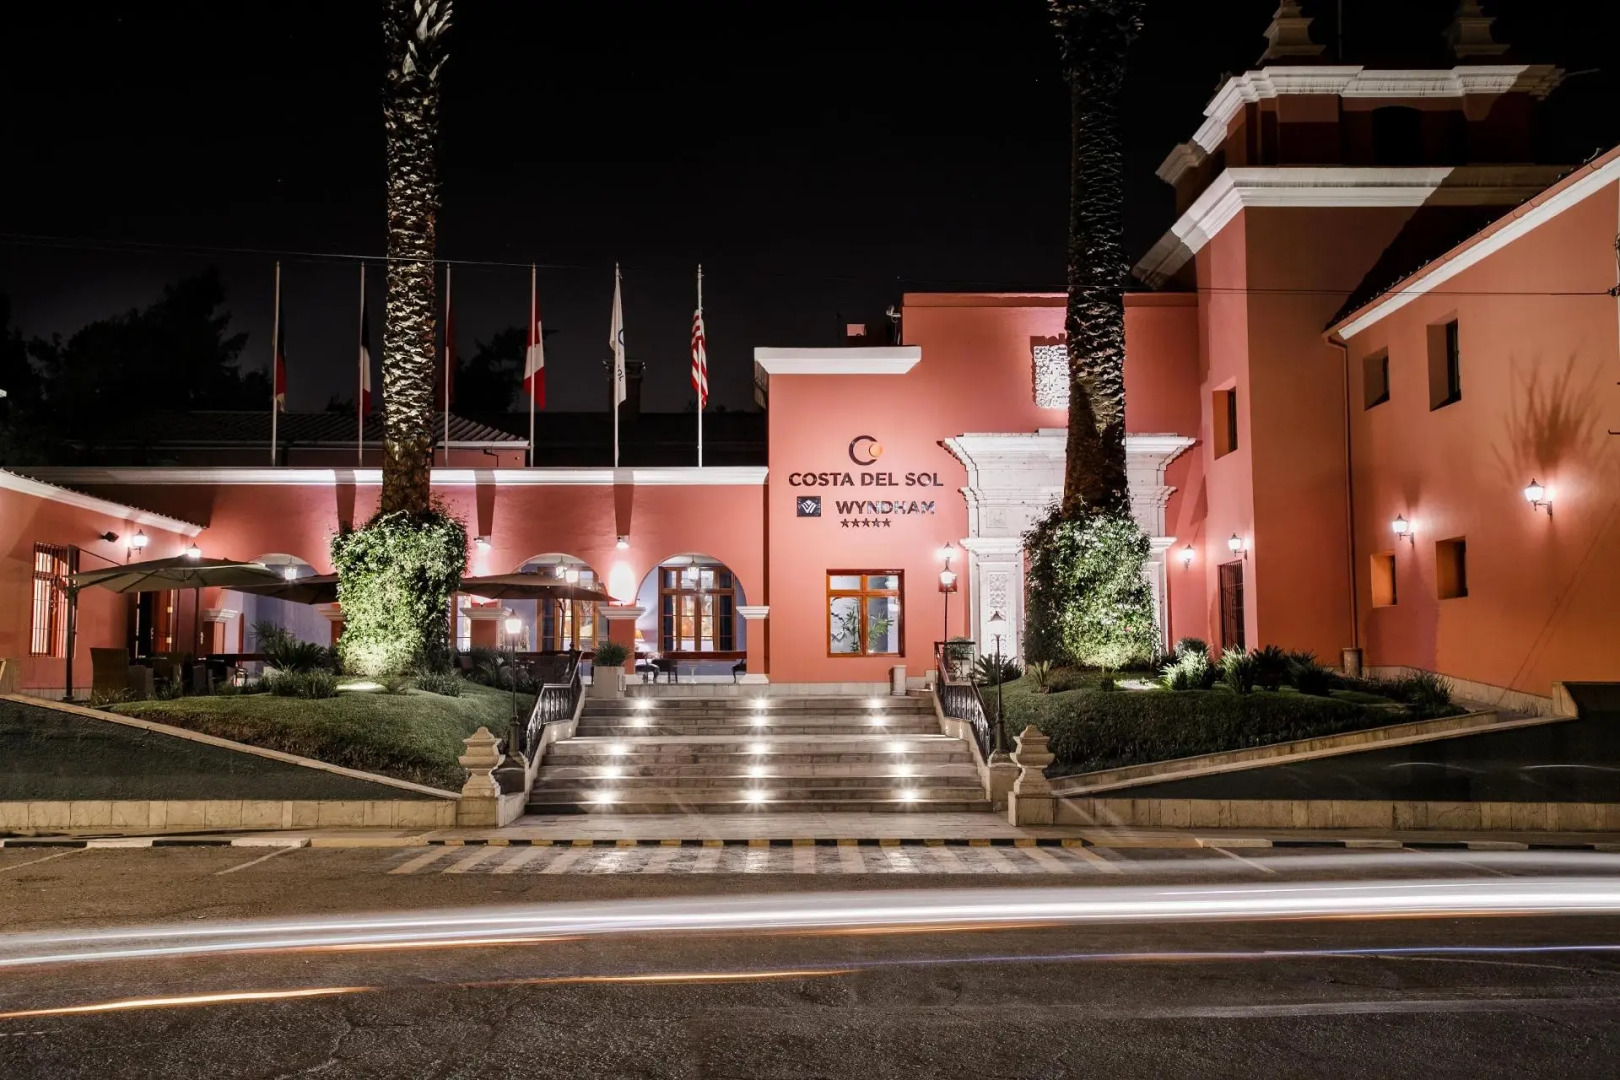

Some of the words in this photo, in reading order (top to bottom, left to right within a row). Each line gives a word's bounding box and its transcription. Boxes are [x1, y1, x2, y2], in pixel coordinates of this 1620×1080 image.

[788, 472, 855, 487] COSTA
[860, 472, 899, 487] DEL
[905, 472, 944, 487] SOL
[835, 500, 936, 515] WYNDHAM
